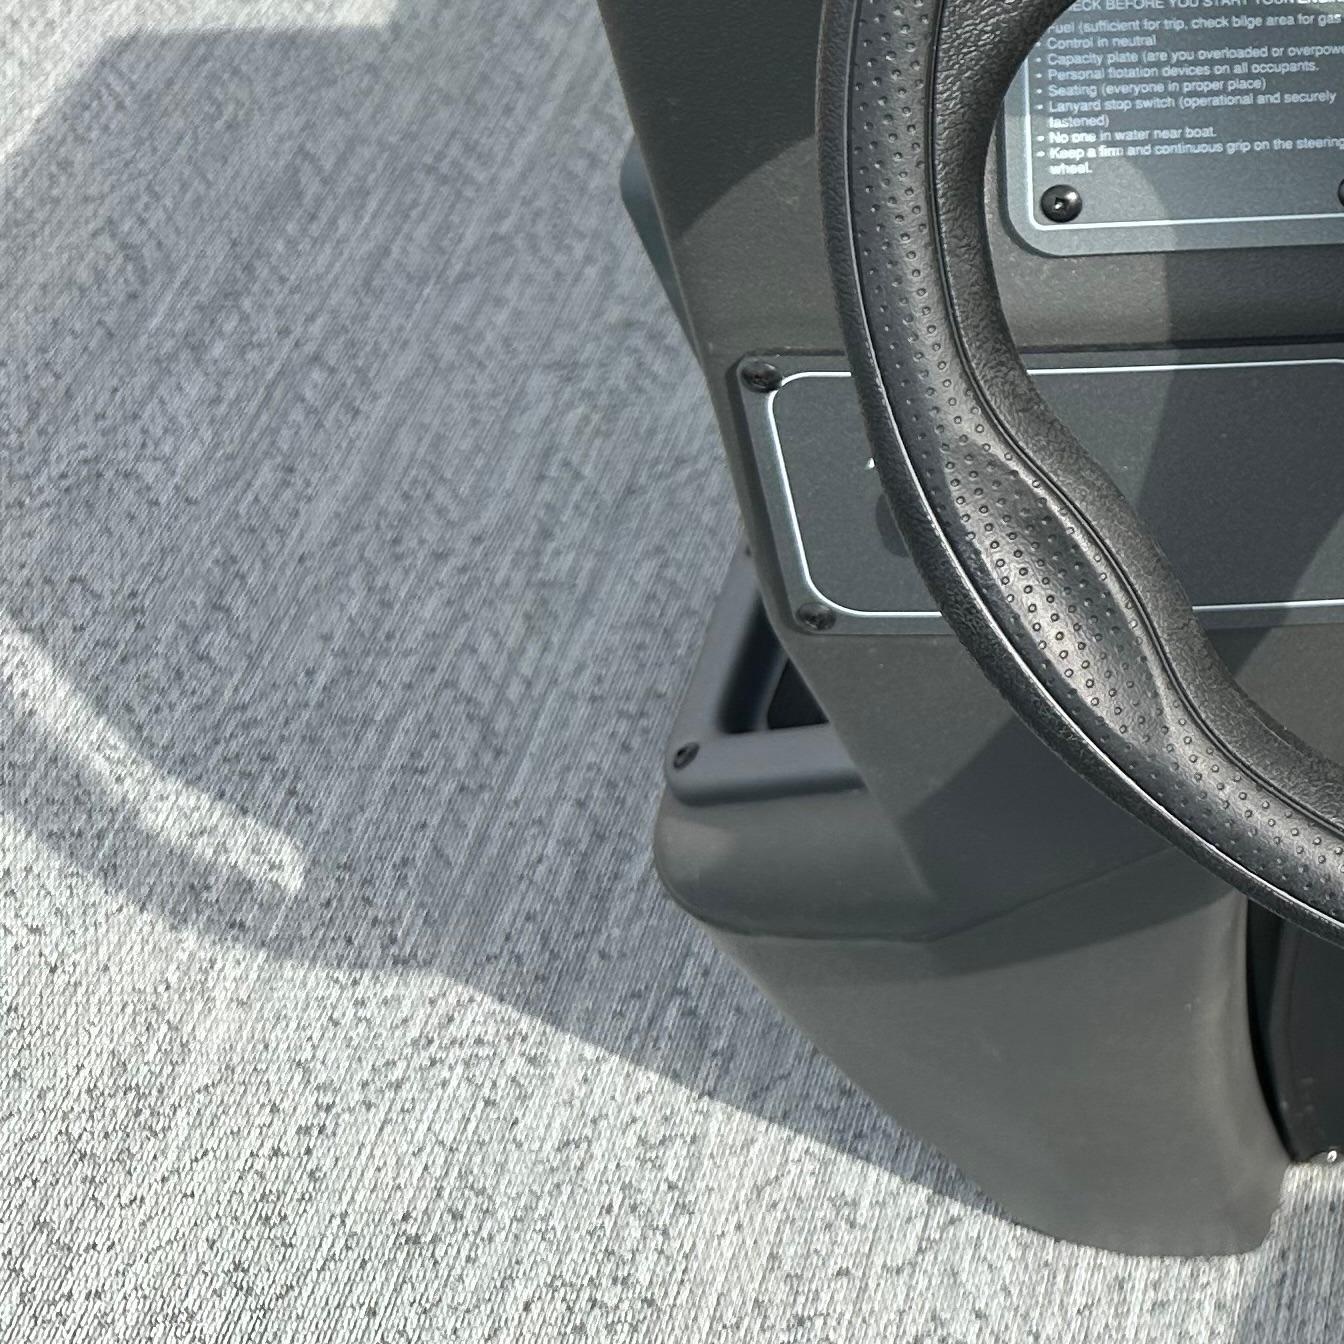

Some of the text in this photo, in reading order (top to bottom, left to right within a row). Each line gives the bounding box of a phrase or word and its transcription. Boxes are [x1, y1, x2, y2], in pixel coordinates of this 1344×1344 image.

[1079, 19, 1141, 34] (sufficient
[1143, 18, 1162, 30] for
[1191, 16, 1229, 29] check
[1232, 15, 1263, 29] bilge
[1265, 15, 1295, 26] area
[1297, 13, 1315, 25] for
[1317, 13, 1341, 26] gas
[1047, 34, 1157, 49] Control in neutral
[1047, 52, 1103, 67] Capacity
[1107, 51, 1139, 65] plate
[1142, 50, 1168, 64] (are
[1171, 51, 1195, 64] you
[1198, 46, 1269, 60] overloaded
[1271, 47, 1285, 57] or
[1048, 61, 1319, 81] Personal flotation devices on all occupants.
[1048, 77, 1267, 98] Seating (everyone in proper place)
[1048, 89, 1337, 114] Lanyard stop switch (operational and securely
[1049, 114, 1110, 128] fastened)
[1049, 126, 1217, 144] No one in water near boat.
[1049, 146, 1085, 160] Keep
[1086, 147, 1097, 158] a
[1098, 144, 1125, 157] firm
[1127, 143, 1152, 156] and
[1154, 141, 1223, 155] continuous
[1226, 139, 1251, 154] grip
[1253, 139, 1270, 151] on
[1273, 138, 1294, 149] the
[1049, 161, 1094, 175] wheel.
